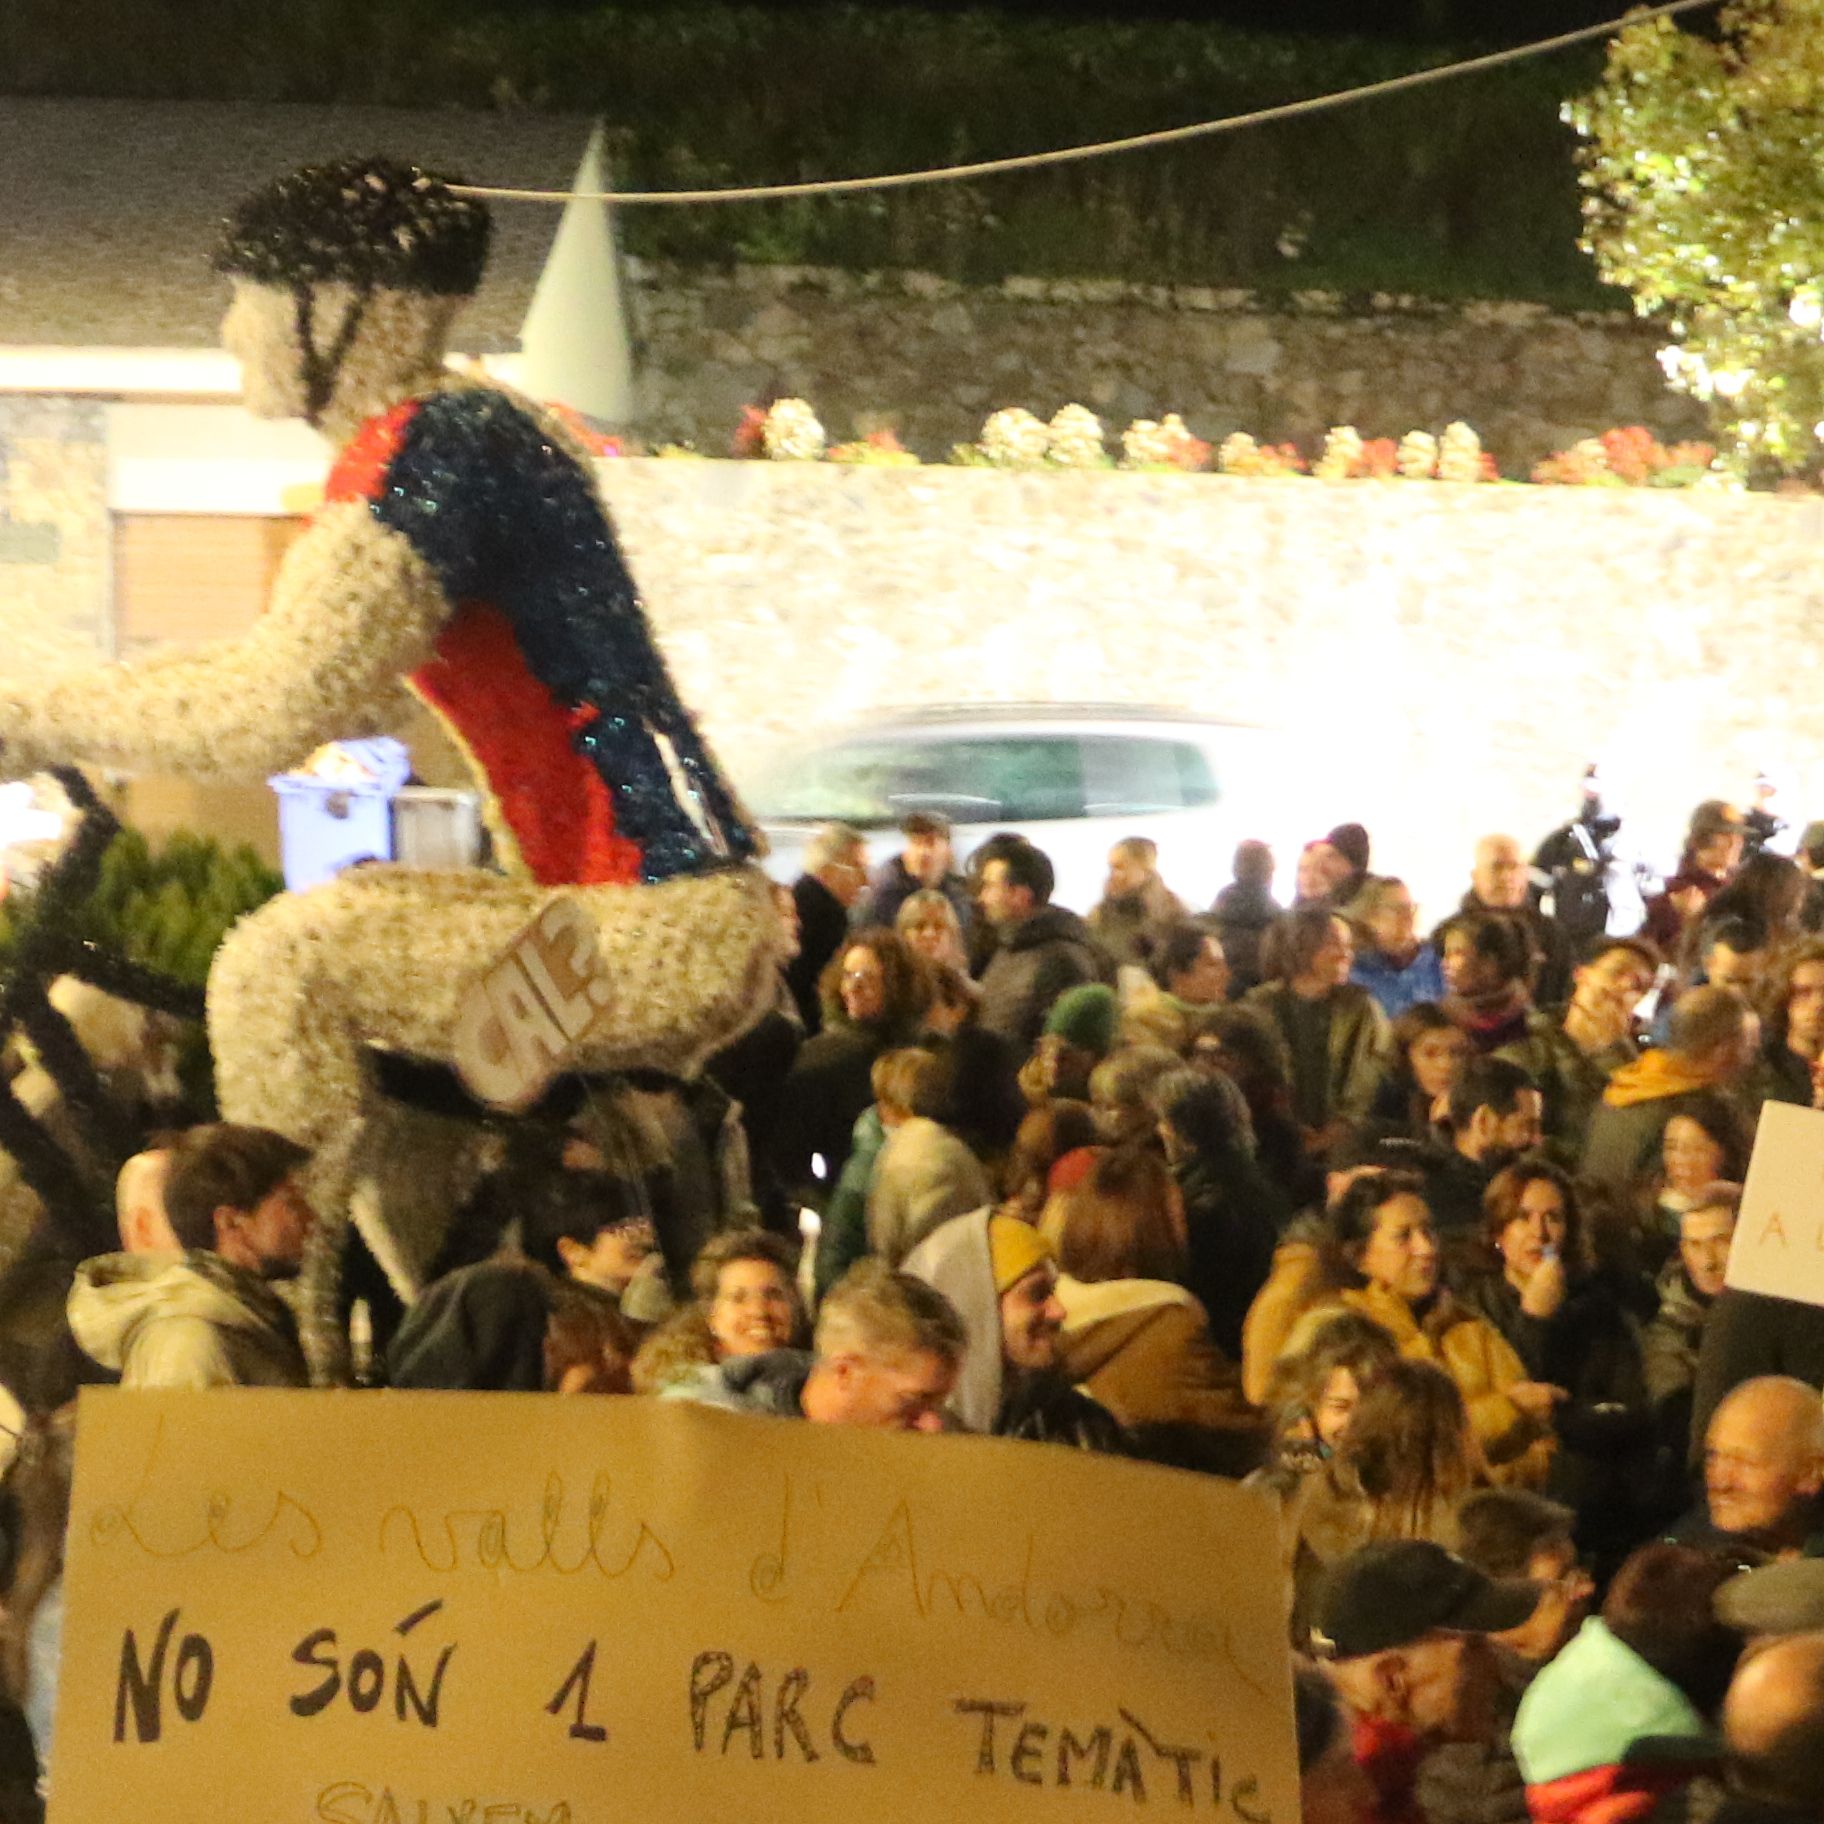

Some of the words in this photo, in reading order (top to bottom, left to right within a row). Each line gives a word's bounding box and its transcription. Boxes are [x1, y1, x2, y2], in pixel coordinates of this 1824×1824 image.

[1758, 1211, 1788, 1249] A
[90, 1412, 323, 1558] Les
[378, 1470, 675, 1582] valls
[114, 1607, 215, 1743] NO
[545, 1639, 607, 1742] 1
[689, 1650, 877, 1766] PARC
